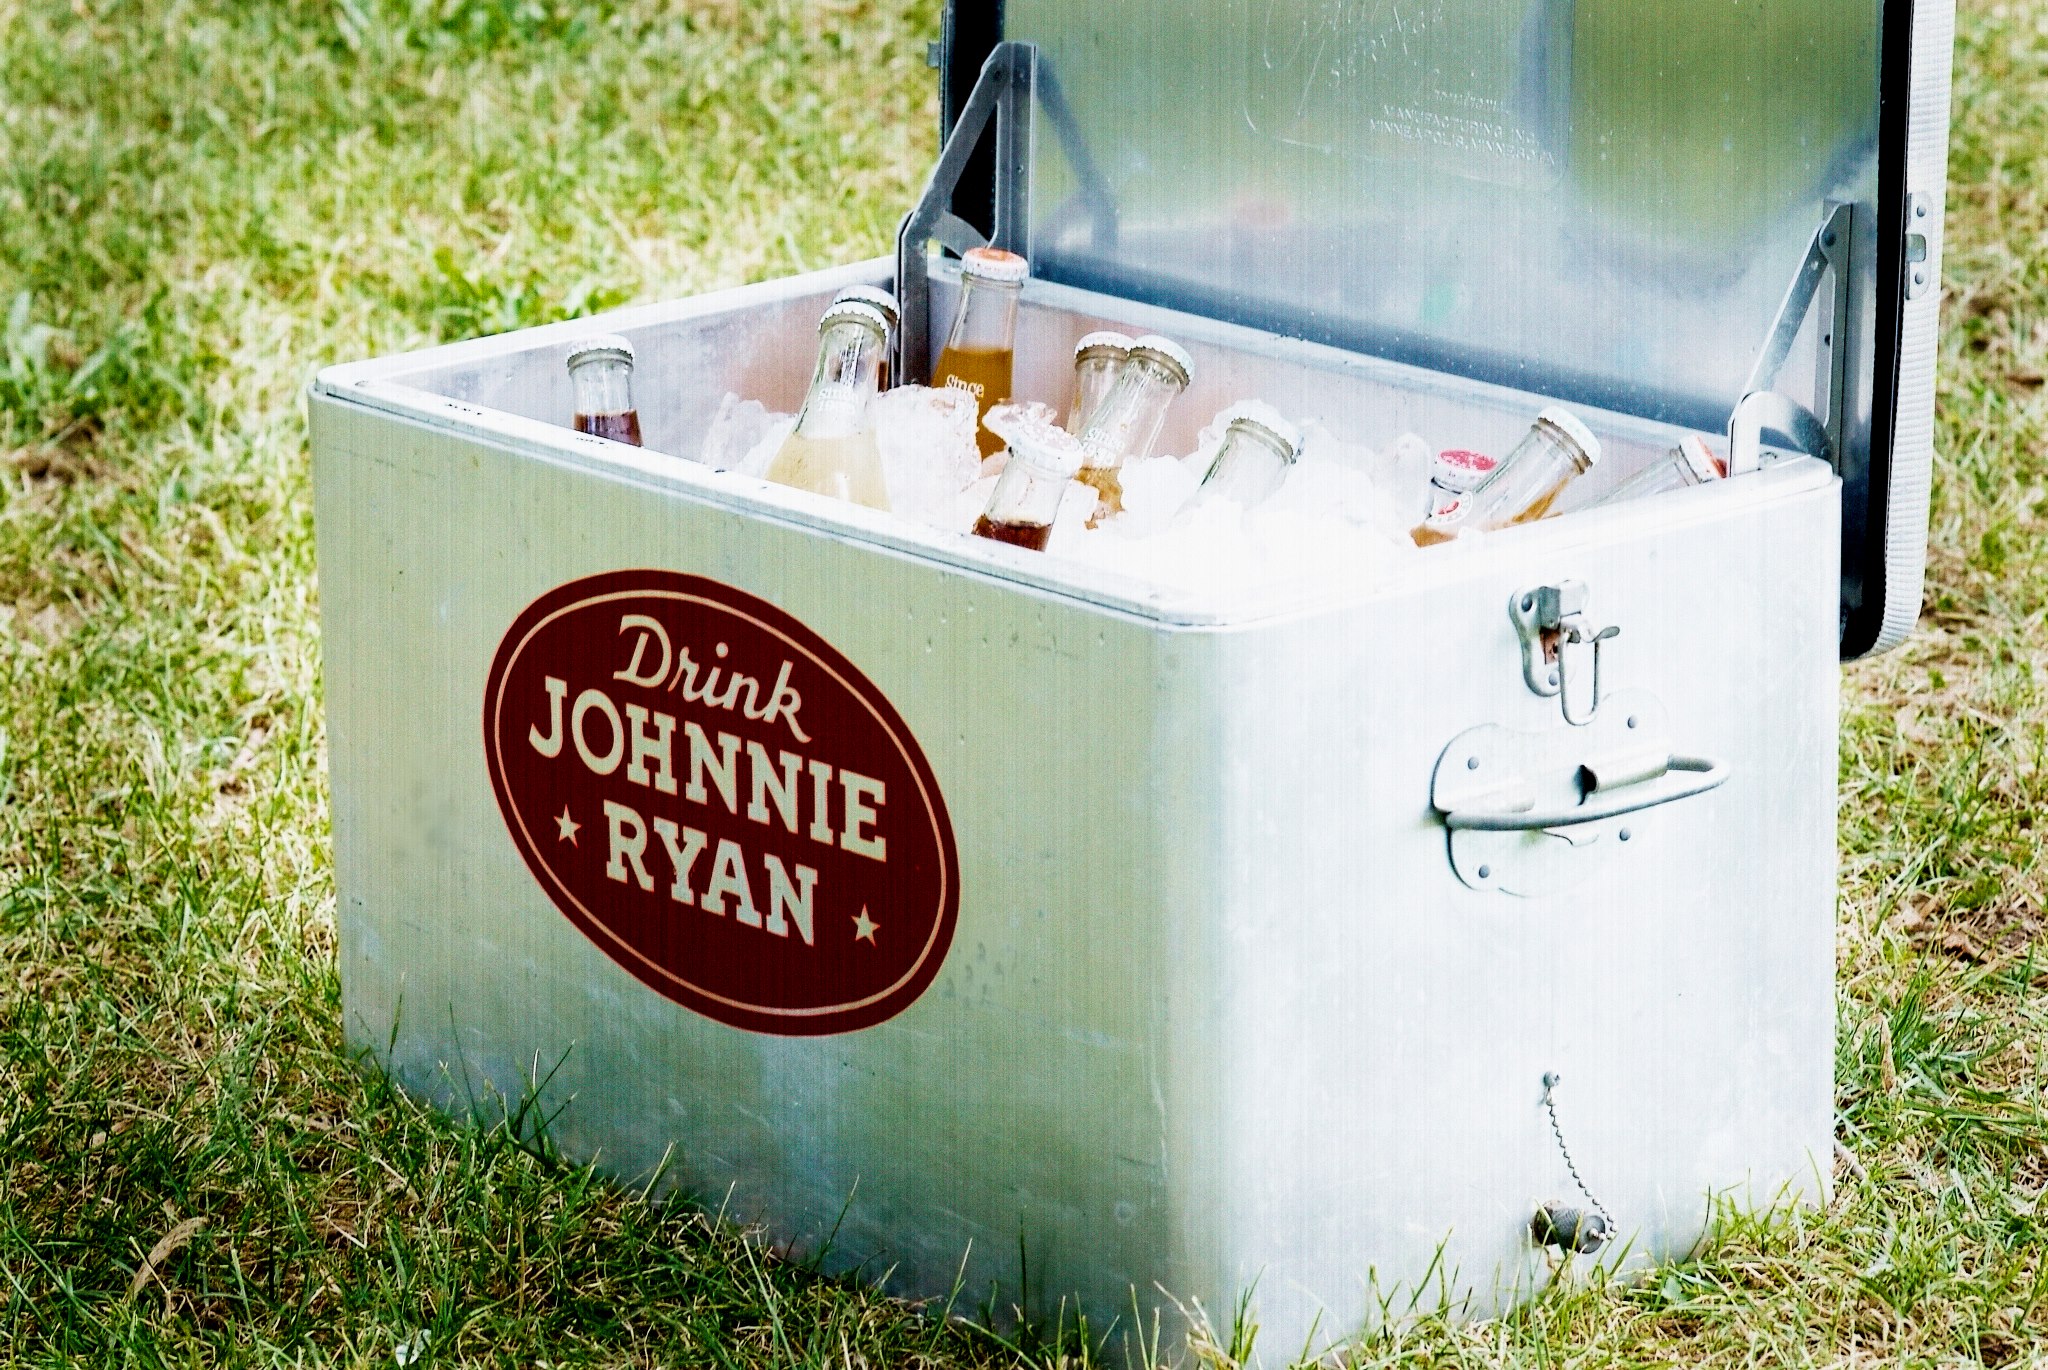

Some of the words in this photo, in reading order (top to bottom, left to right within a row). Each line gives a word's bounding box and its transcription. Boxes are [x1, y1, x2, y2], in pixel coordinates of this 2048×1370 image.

[612, 614, 812, 744] Drink
[528, 675, 887, 863] JOHNNIE
[603, 799, 818, 947] RYAN
